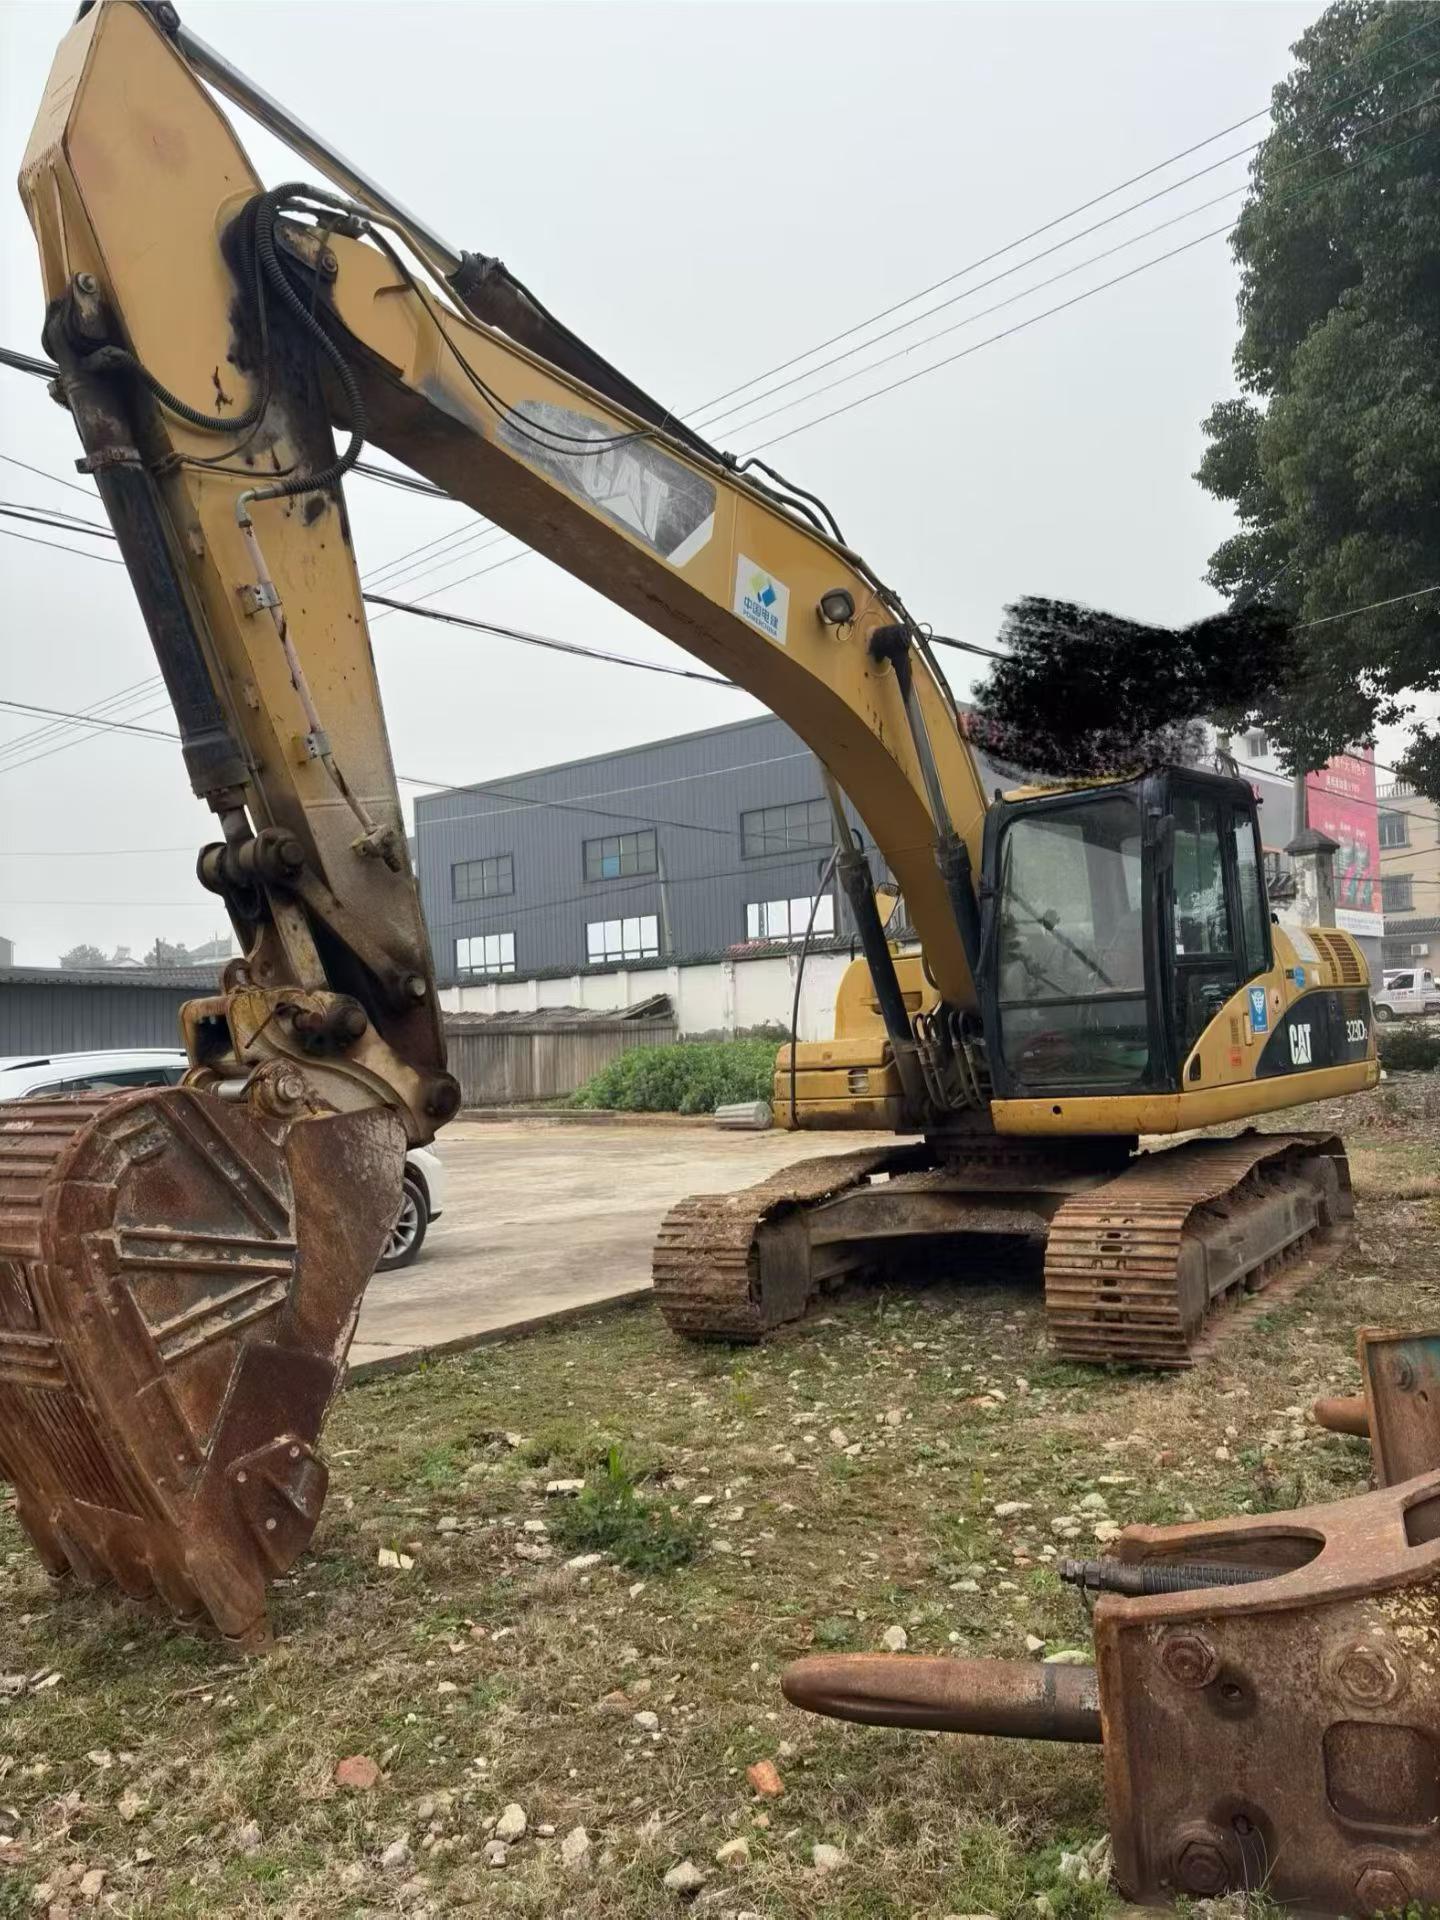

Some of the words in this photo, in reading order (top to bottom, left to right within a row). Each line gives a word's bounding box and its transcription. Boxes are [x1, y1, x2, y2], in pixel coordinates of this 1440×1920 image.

[743, 596, 779, 629] 中国电建
[1289, 1024, 1312, 1065] CAT
